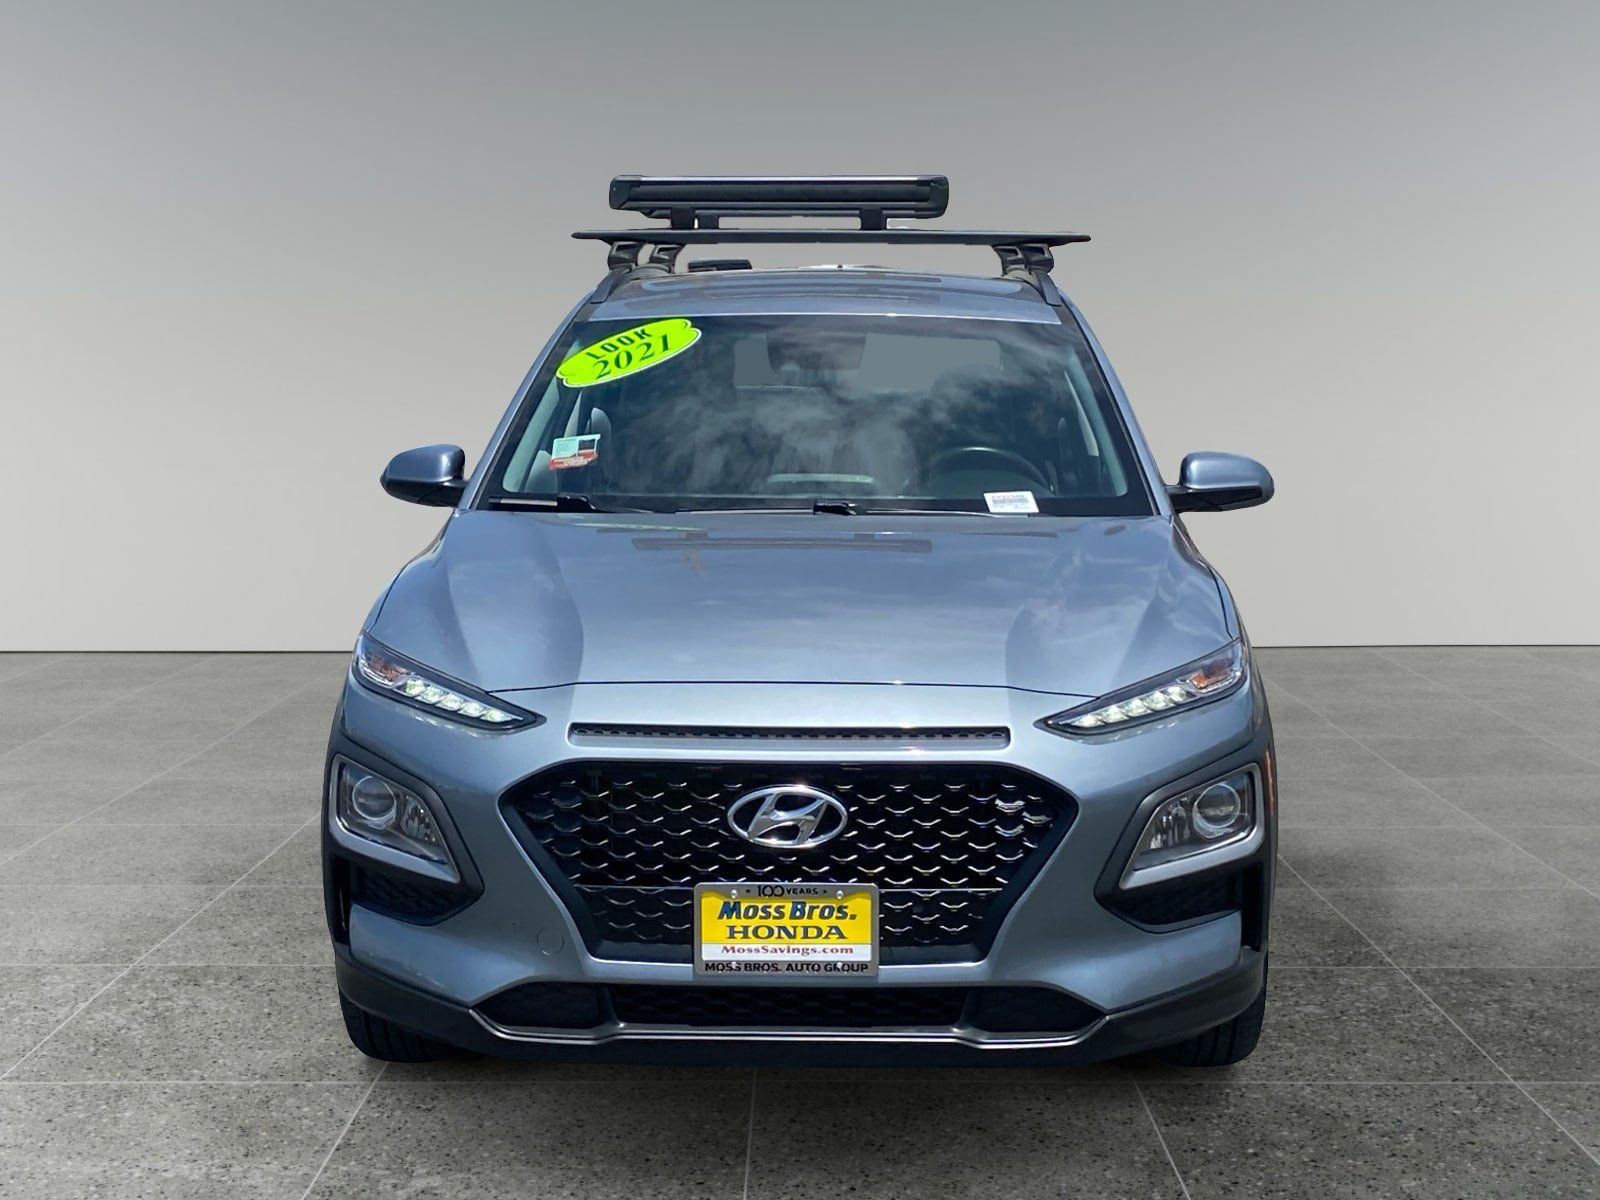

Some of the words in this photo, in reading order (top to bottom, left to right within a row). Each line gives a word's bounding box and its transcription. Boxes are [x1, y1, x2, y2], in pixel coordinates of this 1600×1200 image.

[585, 328, 652, 360] LOOK
[593, 334, 670, 380] 2021
[757, 884, 785, 898] 100
[786, 887, 818, 896] YEARS
[717, 901, 786, 920] Moss
[789, 901, 857, 920] Bros.
[726, 925, 848, 940] HONDA
[721, 945, 854, 956] MossSavings.com
[705, 963, 743, 973] MOSS
[744, 963, 782, 973] BROS.
[786, 963, 821, 973] AUTO
[824, 963, 869, 973] GROUP
